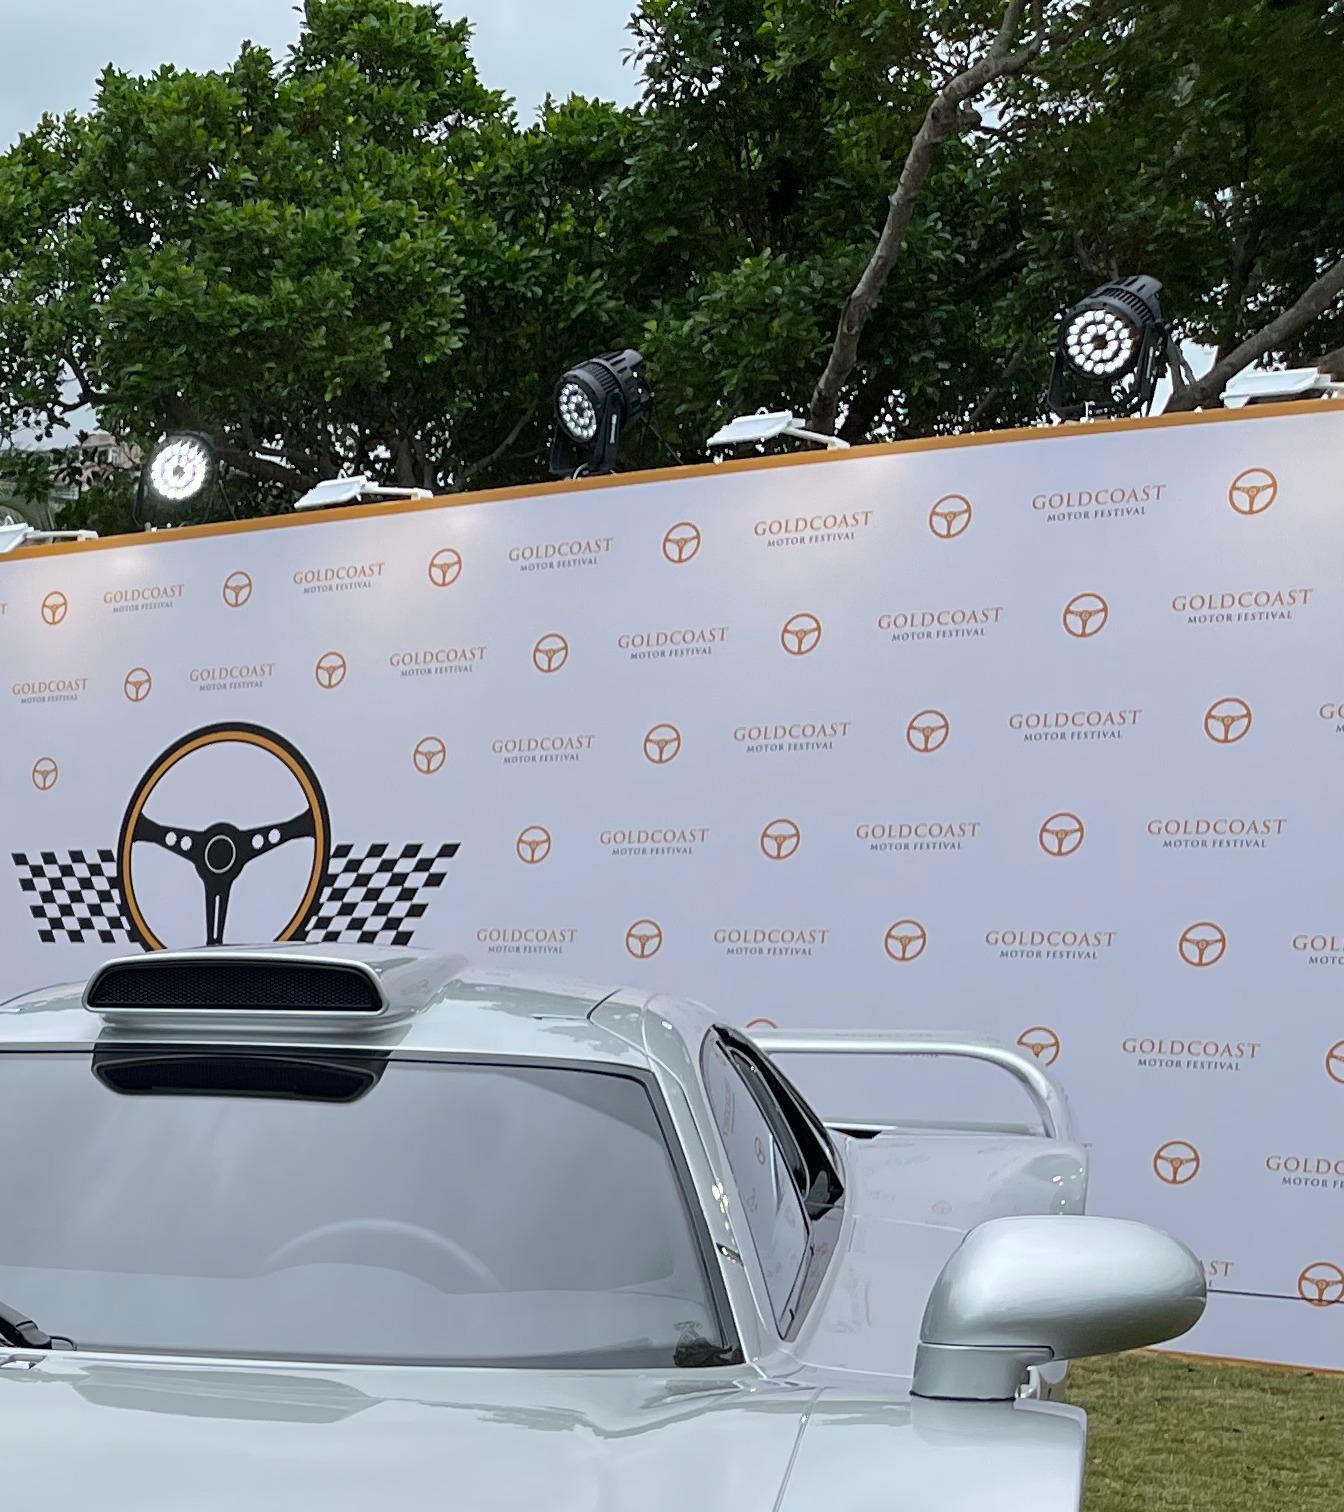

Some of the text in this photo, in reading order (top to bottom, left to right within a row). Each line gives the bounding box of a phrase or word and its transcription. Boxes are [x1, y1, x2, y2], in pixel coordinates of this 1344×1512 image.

[1031, 483, 1167, 511] GOLDCOAST
[1047, 506, 1147, 523] MOTOR FESTIVAL
[753, 510, 874, 537] GOLDCOAST
[767, 531, 856, 548] MOTOR FESTIVAL
[508, 536, 614, 562] GOLDCOAST
[520, 556, 599, 573] MOTOR FESTIVAL
[292, 562, 385, 585] GOLDCOAST
[103, 583, 185, 605] GOLDCOAST
[303, 584, 334, 595] MOTOR
[1171, 588, 1314, 612] GOLDCOAST
[113, 604, 140, 614] MOTOR
[1188, 610, 1294, 624] MOTOR FESTIVAL
[877, 606, 1005, 630] GOLDCOAST
[617, 626, 729, 650] GOLDCOAST
[892, 627, 986, 642] MOTOR FESTIVAL
[389, 646, 488, 667] GOLDCOAST
[630, 646, 713, 661] MOTOR FESTIVAL
[189, 663, 276, 682] GOLDCOAST
[400, 667, 433, 678] MOTOR
[12, 678, 89, 696] GOLDCOAST
[199, 682, 228, 692] MOTOR
[1008, 708, 1143, 730] GOLDCOAST
[733, 721, 852, 742] GOLDCOAST
[1024, 729, 1123, 742] MOTOR FESTIVAL
[491, 734, 595, 754] GOLDCOAST
[746, 741, 835, 754] MOTOR FESTIVAL
[503, 753, 581, 765] MOTOR FESTIVAL
[855, 821, 981, 839] GOLDCOAST
[1146, 818, 1288, 835] GOLDCOAST
[599, 828, 710, 845] GOLDCOAST
[1163, 839, 1268, 849] MOTOR FESTIVAL
[612, 846, 694, 856] MOTOR FESTIVAL
[870, 841, 963, 852] MOTOR FESTIVAL
[476, 928, 578, 943] GOLDCOAST
[713, 929, 830, 944] GOLDCOAST
[984, 930, 1118, 947] GOLDCOAST
[488, 945, 564, 954] MOTOR FESTIVAL
[726, 947, 813, 956] MOTOR FESTIVAL
[1000, 949, 1099, 960] MOTOR FESTIVAL
[1308, 955, 1344, 965] MOTO
[1121, 1037, 1262, 1059] GOLDCOAST
[1137, 1058, 1241, 1072] MOTOR FESTIVAL
[1266, 1155, 1344, 1175] GOLDC
[1281, 1176, 1329, 1188] MOTOR
